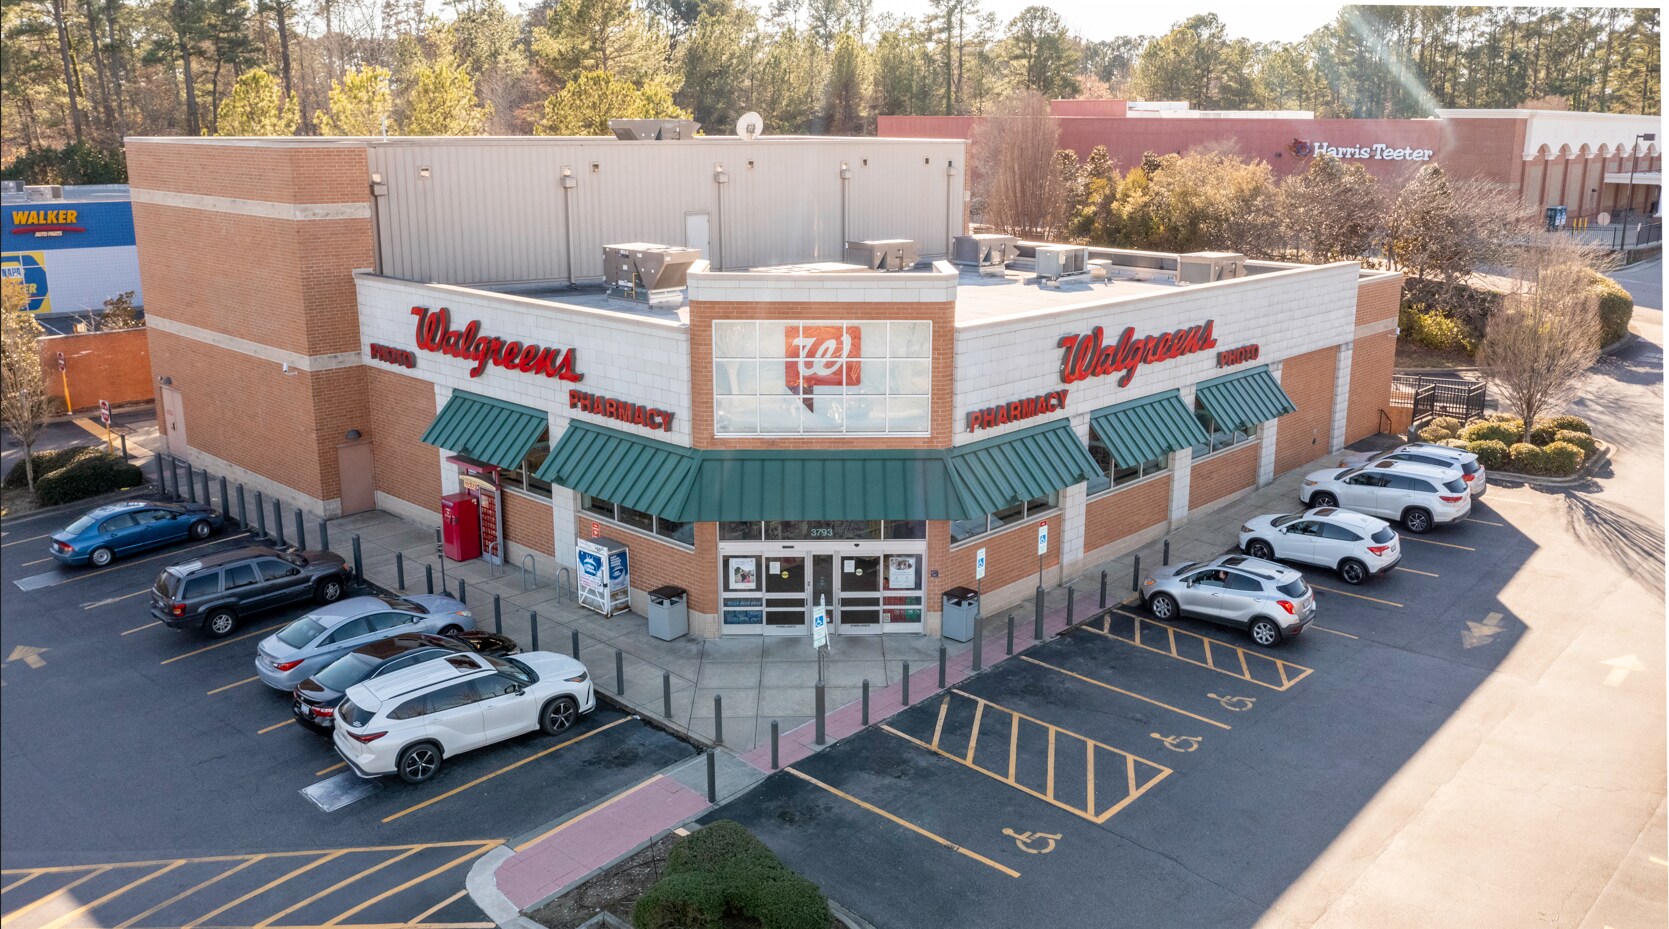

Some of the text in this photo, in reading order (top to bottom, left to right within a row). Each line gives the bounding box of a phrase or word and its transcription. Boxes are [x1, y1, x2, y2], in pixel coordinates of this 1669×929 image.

[1313, 142, 1433, 161] Harris Teeter
[13, 210, 77, 225] WALKER
[2, 268, 21, 277] NAPA
[370, 343, 416, 369] PHOTO
[410, 306, 583, 383] Walgreens
[1058, 319, 1217, 388] Walgreens
[1218, 343, 1260, 369] PHOTO
[569, 389, 674, 432] PHARMACY
[967, 389, 1070, 433] PHARMACY
[810, 528, 833, 537] 3793
